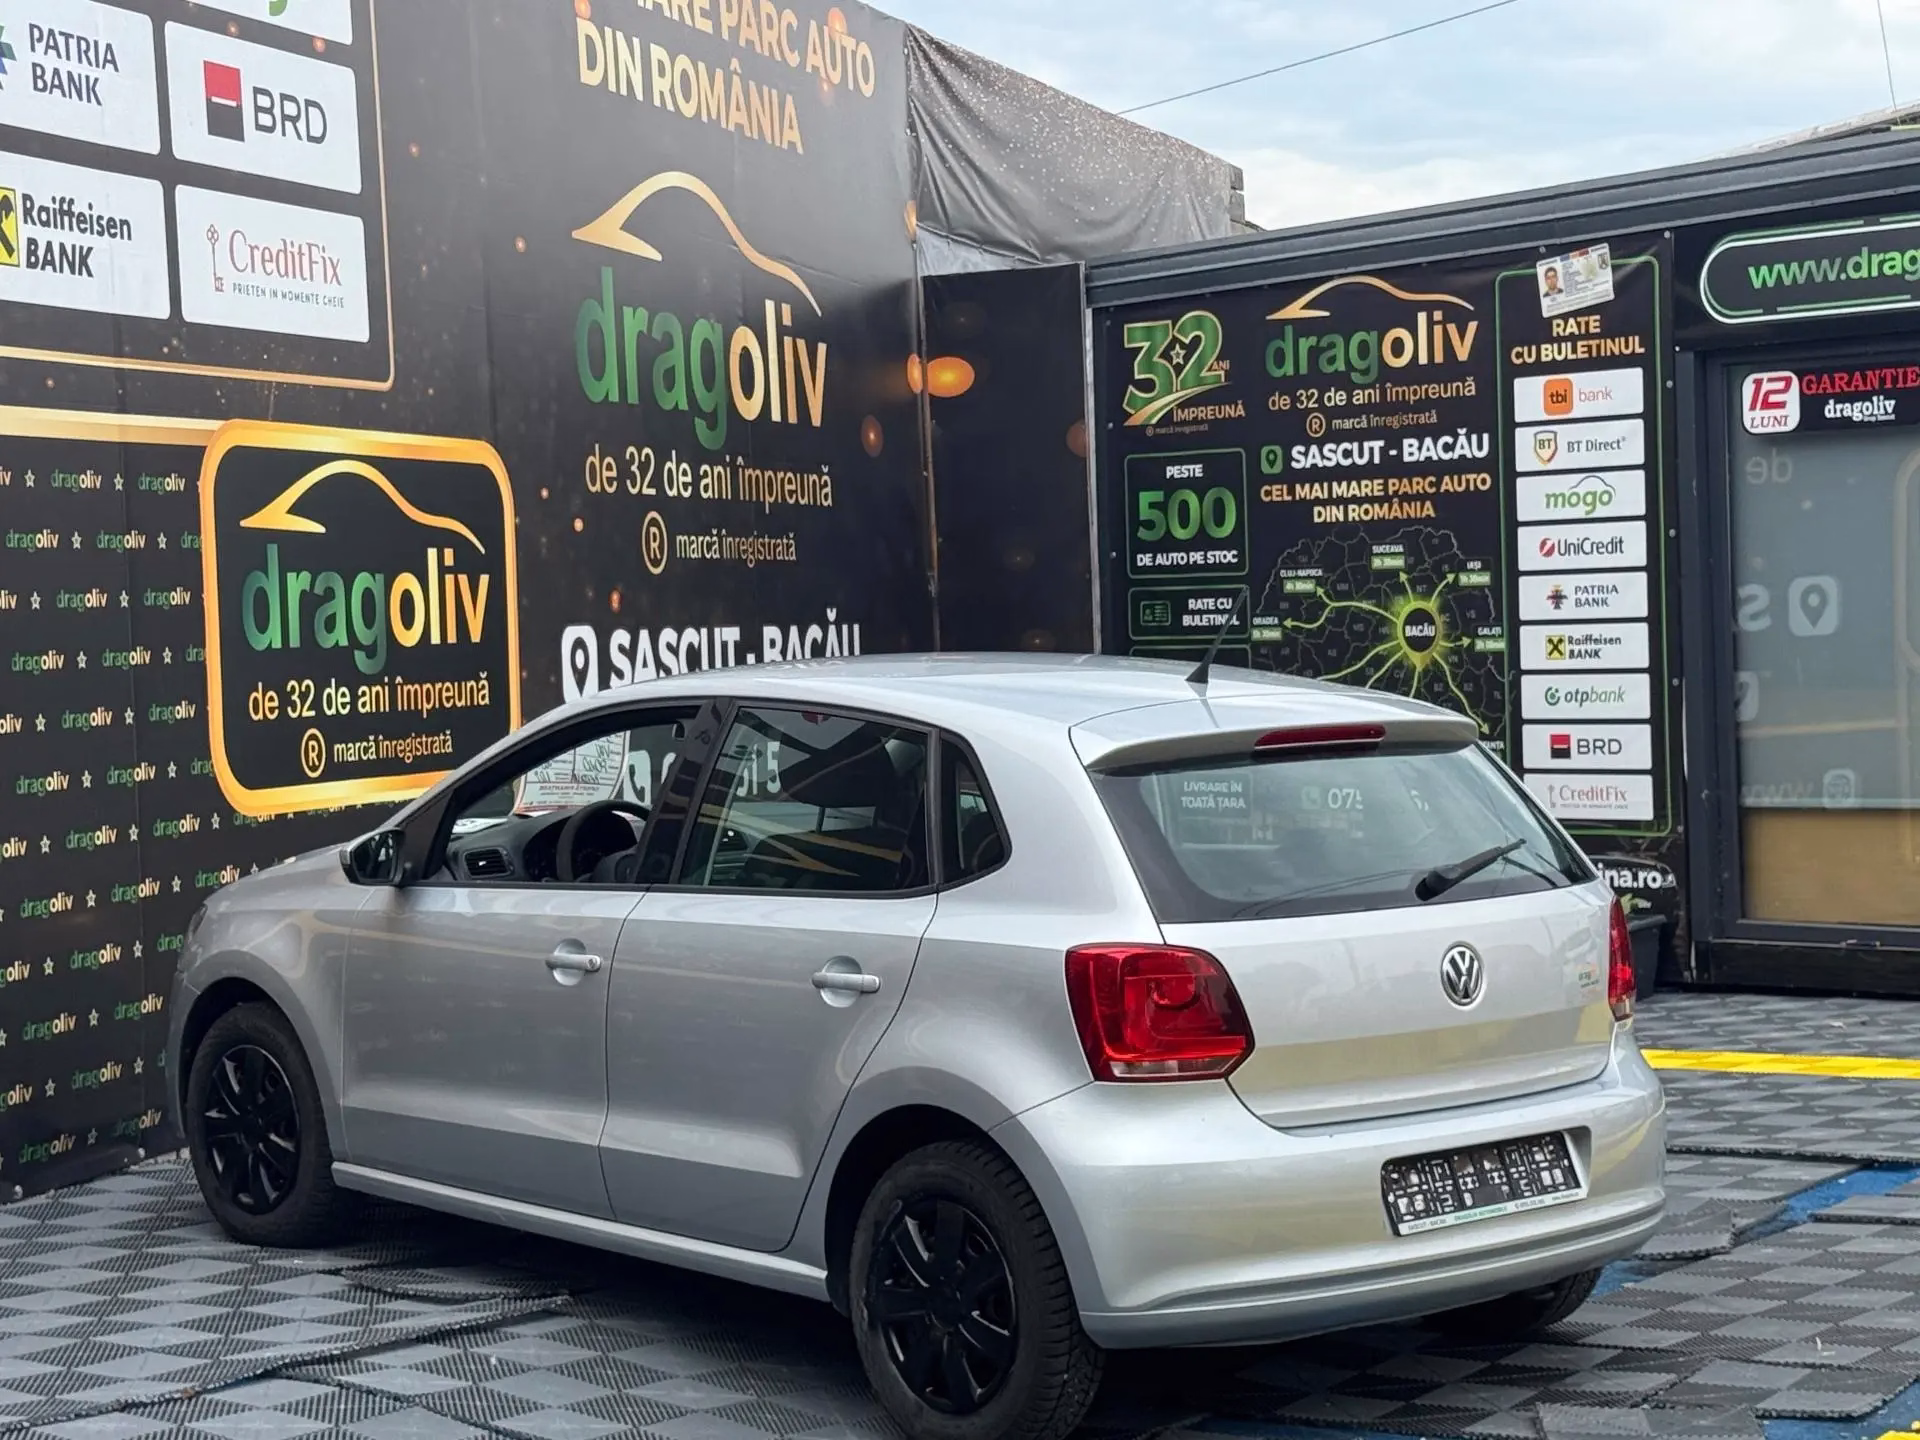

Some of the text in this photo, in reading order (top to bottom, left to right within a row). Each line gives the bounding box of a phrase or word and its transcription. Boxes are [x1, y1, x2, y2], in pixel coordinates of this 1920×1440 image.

[28, 22, 119, 73] PATRIA
[718, 0, 801, 67] PARC
[805, 19, 876, 98] AUTO
[31, 62, 102, 106] BANK
[575, 18, 803, 154] DIN ROMÂNIA
[252, 85, 328, 145] BRD
[22, 193, 132, 241] Raiffeisen
[25, 237, 94, 279] BANK
[229, 229, 342, 286] CreditFix
[232, 282, 266, 298] PRIETEN
[269, 287, 278, 299] IN
[281, 288, 319, 305] MOMENTE
[1552, 315, 1601, 337] RATE
[575, 266, 827, 450] dragoliv
[1265, 310, 1479, 384] dragoliv
[1510, 335, 1645, 365] CU BULETINUL
[1268, 376, 1476, 411] de 32 de ani împreună
[1749, 376, 1793, 412] 12
[1802, 366, 1920, 395] GARANTIE
[1549, 387, 1613, 405] tbi bank
[1824, 395, 1896, 421] dragoliv
[1173, 400, 1246, 422] ÎMPREUNĂ
[1331, 412, 1368, 431] marcă
[1369, 409, 1437, 430] înregistrată
[1750, 414, 1790, 429] LUNI
[1290, 439, 1385, 470] SASCUT
[1402, 428, 1490, 462] BACĂU
[1537, 438, 1553, 450] BT
[1567, 440, 1583, 453] BT
[51, 469, 102, 493] dragoliv
[138, 472, 186, 495] dragoliv
[585, 443, 833, 514] de 32 de ani împreună
[1166, 464, 1204, 479] PESTE
[1260, 472, 1491, 502] CEL MAI MARE PARC AUTO
[1136, 486, 1237, 542] 500
[1313, 497, 1436, 523] DIN ROMÂNIA
[1545, 489, 1614, 516] mogo
[6, 529, 59, 553] dragoliv
[97, 529, 146, 553] dragoliv
[676, 527, 720, 560] marcă
[721, 528, 797, 568] înregistrată
[1557, 536, 1625, 557] UniCredit
[1136, 550, 1239, 567] DE AUTO PE STOC
[56, 588, 108, 612] dragoliv
[143, 587, 191, 610] dragoliv
[1188, 597, 1233, 610] RATE CU
[1574, 584, 1620, 597] PATRIA
[1574, 597, 1610, 608] BANK
[241, 543, 490, 675] dragoliv
[1404, 622, 1436, 637] BACĂU
[1567, 634, 1622, 646] Raiffeisen
[11, 650, 64, 675] dragoliv
[102, 646, 151, 670] dragoliv
[1568, 648, 1602, 660] BANK
[249, 671, 490, 721] de 32 de ani împreună
[1564, 685, 1626, 708] otpbank
[61, 707, 113, 732] dragoliv
[148, 701, 196, 724] dragoliv
[333, 735, 377, 763] marcă
[378, 730, 453, 763] înregistrată
[1576, 738, 1623, 756] BRD
[16, 771, 70, 797] dragoliv
[107, 762, 156, 787] dragoliv
[1184, 780, 1243, 793] LIVRARE ÎN
[1559, 784, 1628, 802] CreditFix
[1181, 794, 1216, 808] TOATĂ
[65, 825, 117, 851] dragoliv
[153, 814, 200, 839] dragoliv
[20, 892, 74, 919] dragoliv
[111, 878, 160, 903] dragoliv
[70, 944, 122, 971] dragoliv
[23, 994, 163, 1041] dragoliv dragoliv
[71, 1062, 123, 1090] dragoliv
